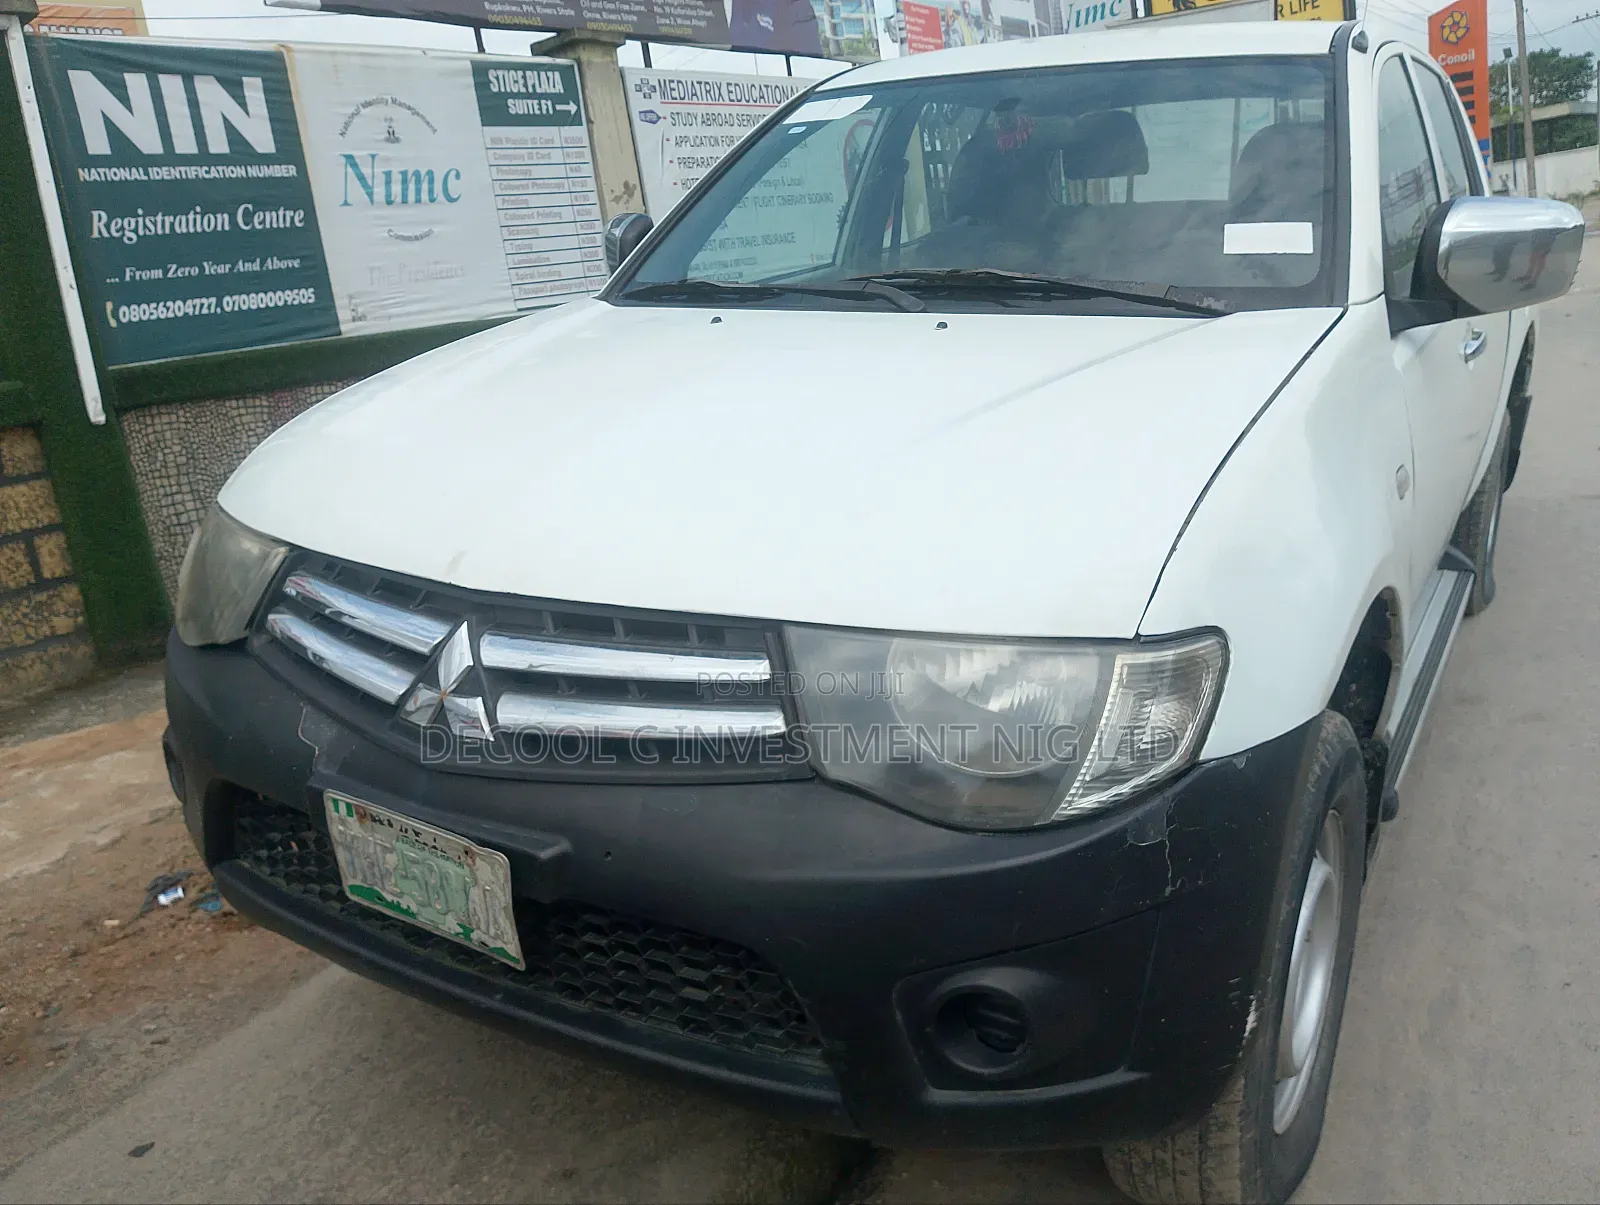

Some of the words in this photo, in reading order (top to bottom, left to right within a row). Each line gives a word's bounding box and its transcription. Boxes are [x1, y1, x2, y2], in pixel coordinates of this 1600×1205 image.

[1438, 49, 1475, 66] Conoil
[488, 68, 526, 93] STICE
[526, 70, 564, 94] PLAZA
[657, 79, 725, 102] MEDIATRIX
[67, 69, 276, 155] NIN
[507, 98, 541, 115] SUITE
[541, 99, 553, 115] F1
[670, 112, 699, 127] STUDY
[700, 112, 735, 127] ABROAD
[675, 135, 720, 148] APPLICATION
[720, 135, 735, 147] FOR
[78, 166, 148, 182] NATIONAL
[148, 164, 246, 181] IDENTIFICATION
[247, 163, 298, 178] NUMBER
[339, 153, 462, 207] Nimc
[90, 205, 230, 244] Registration
[236, 203, 305, 231] Centre
[124, 266, 163, 282] From
[167, 263, 199, 279] Zero
[202, 260, 232, 276] Year
[233, 257, 260, 273] And
[262, 255, 301, 271] Above
[118, 296, 222, 323] 08056204727,
[222, 287, 315, 313] 07080009505
